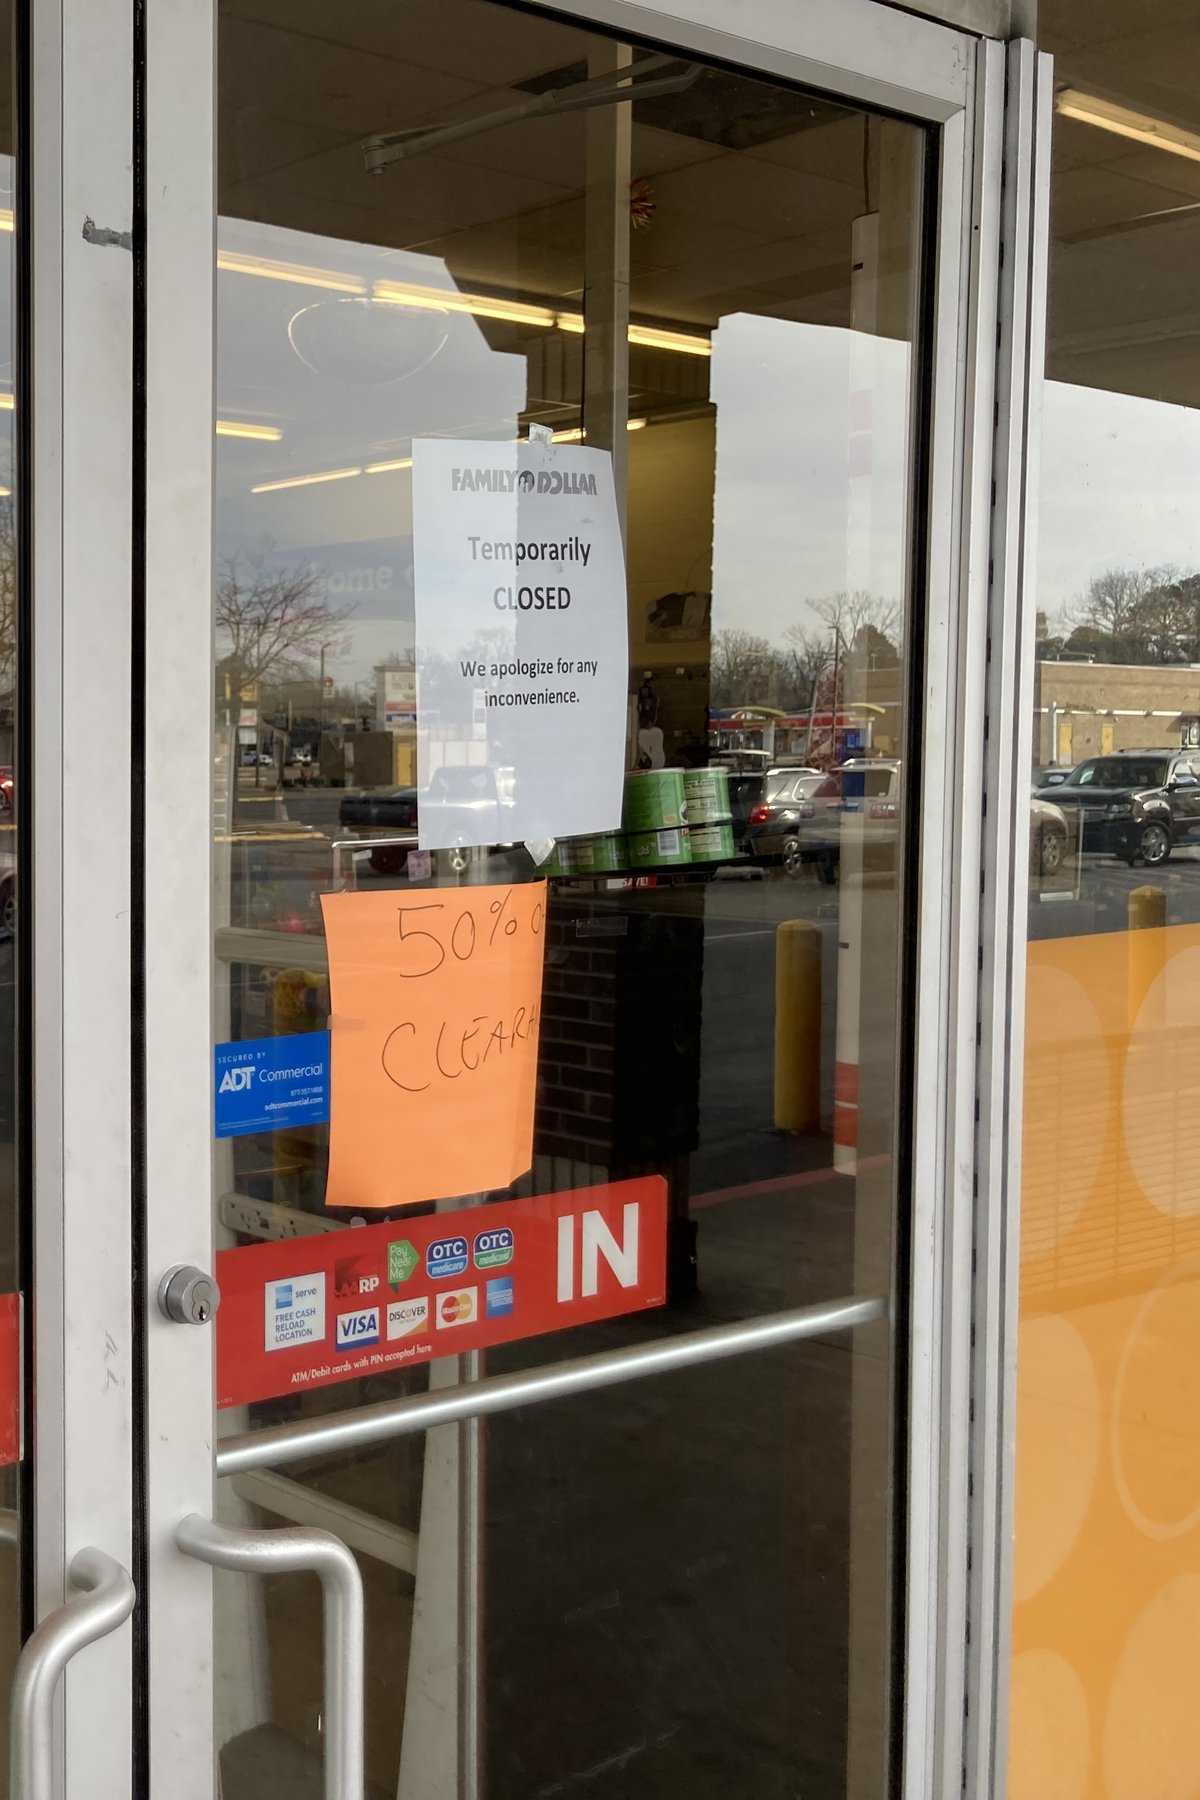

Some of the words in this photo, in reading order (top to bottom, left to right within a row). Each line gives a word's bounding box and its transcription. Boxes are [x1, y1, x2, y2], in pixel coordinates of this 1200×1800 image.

[451, 468, 517, 493] FAMILY
[537, 470, 598, 495] DOLLAR
[467, 537, 591, 566] Temporarily
[493, 586, 571, 610] CLOSED
[460, 661, 486, 677] We
[490, 658, 554, 679] apologize
[556, 658, 574, 674] for
[577, 659, 598, 676] any
[484, 688, 580, 707] inconvenience.
[397, 889, 517, 978] 50%
[531, 903, 545, 935] O
[217, 1053, 253, 1064] SECURED
[218, 1066, 255, 1094] ADT
[259, 1062, 323, 1082] Commercial
[433, 1241, 463, 1259] OTC
[480, 1233, 509, 1249] OTC
[390, 1245, 407, 1258] Pay
[557, 1202, 639, 1303] IN
[390, 1256, 411, 1269] Near
[390, 1270, 404, 1281] Me
[295, 1288, 317, 1298] serve
[275, 1312, 294, 1323] FREE
[295, 1308, 316, 1318] CASH
[389, 1305, 426, 1322] DISCOVER
[275, 1320, 305, 1333] RELOAD
[340, 1313, 377, 1335] VISA
[275, 1328, 313, 1342] LOCATION
[291, 1363, 330, 1383] ATM/Debit
[332, 1360, 352, 1372] cards
[353, 1356, 369, 1368] with
[370, 1354, 383, 1365] PIN
[385, 1348, 415, 1363] accepted
[416, 1345, 432, 1355] here
